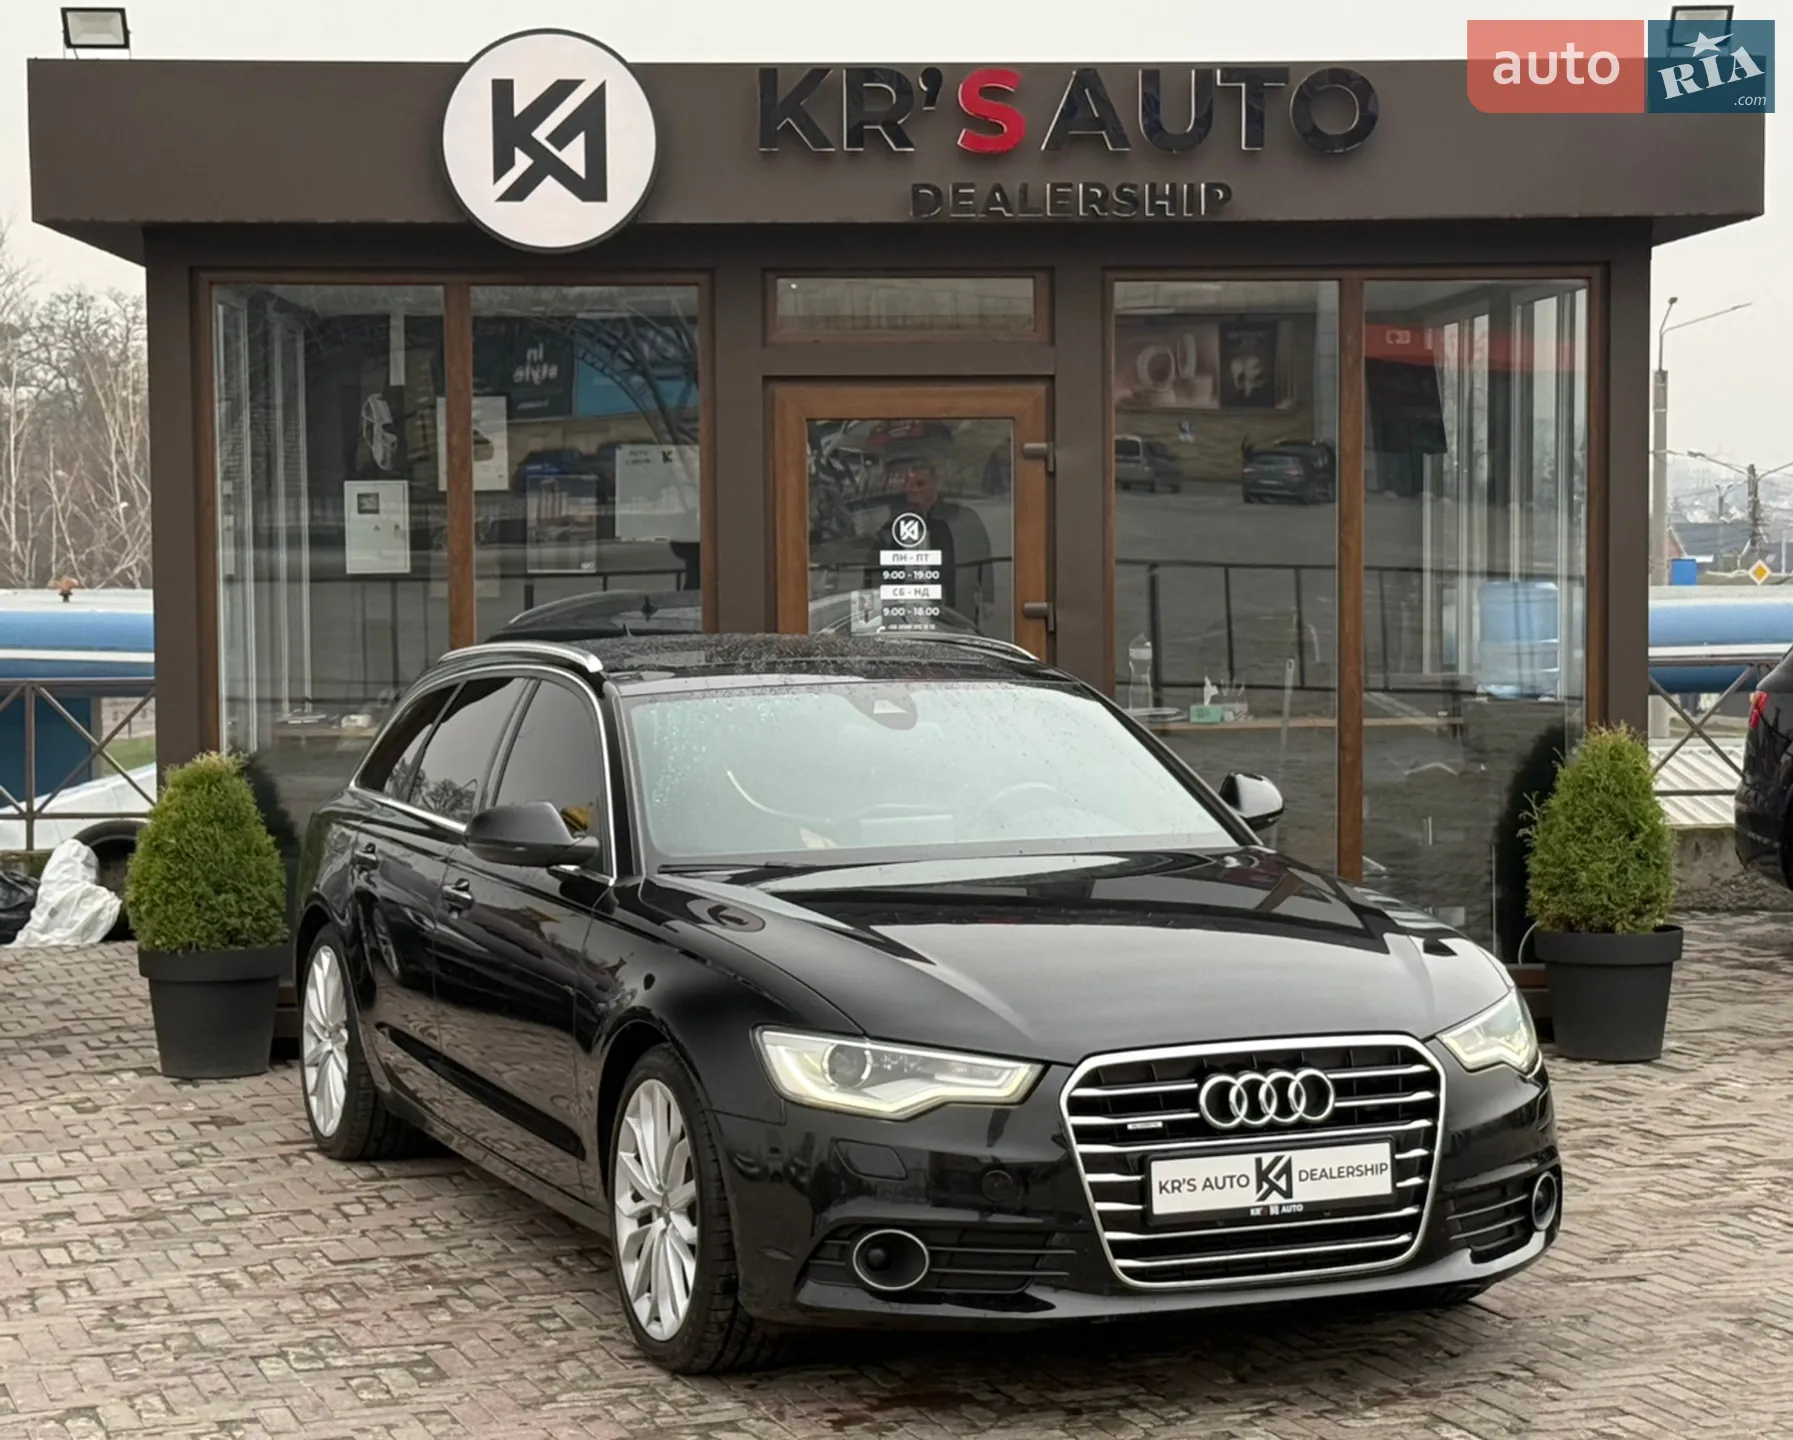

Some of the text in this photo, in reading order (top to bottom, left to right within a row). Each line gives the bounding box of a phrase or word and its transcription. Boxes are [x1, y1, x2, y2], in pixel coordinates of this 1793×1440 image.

[1040, 66, 1380, 154] AUTO
[910, 181, 1233, 218] DEALERSHIP
[1158, 1178, 1197, 1195] KR'S
[1201, 1173, 1250, 1192] AUTO
[1298, 1162, 1389, 1183] DEALERSHIP
[1281, 1203, 1303, 1214] AUTO
